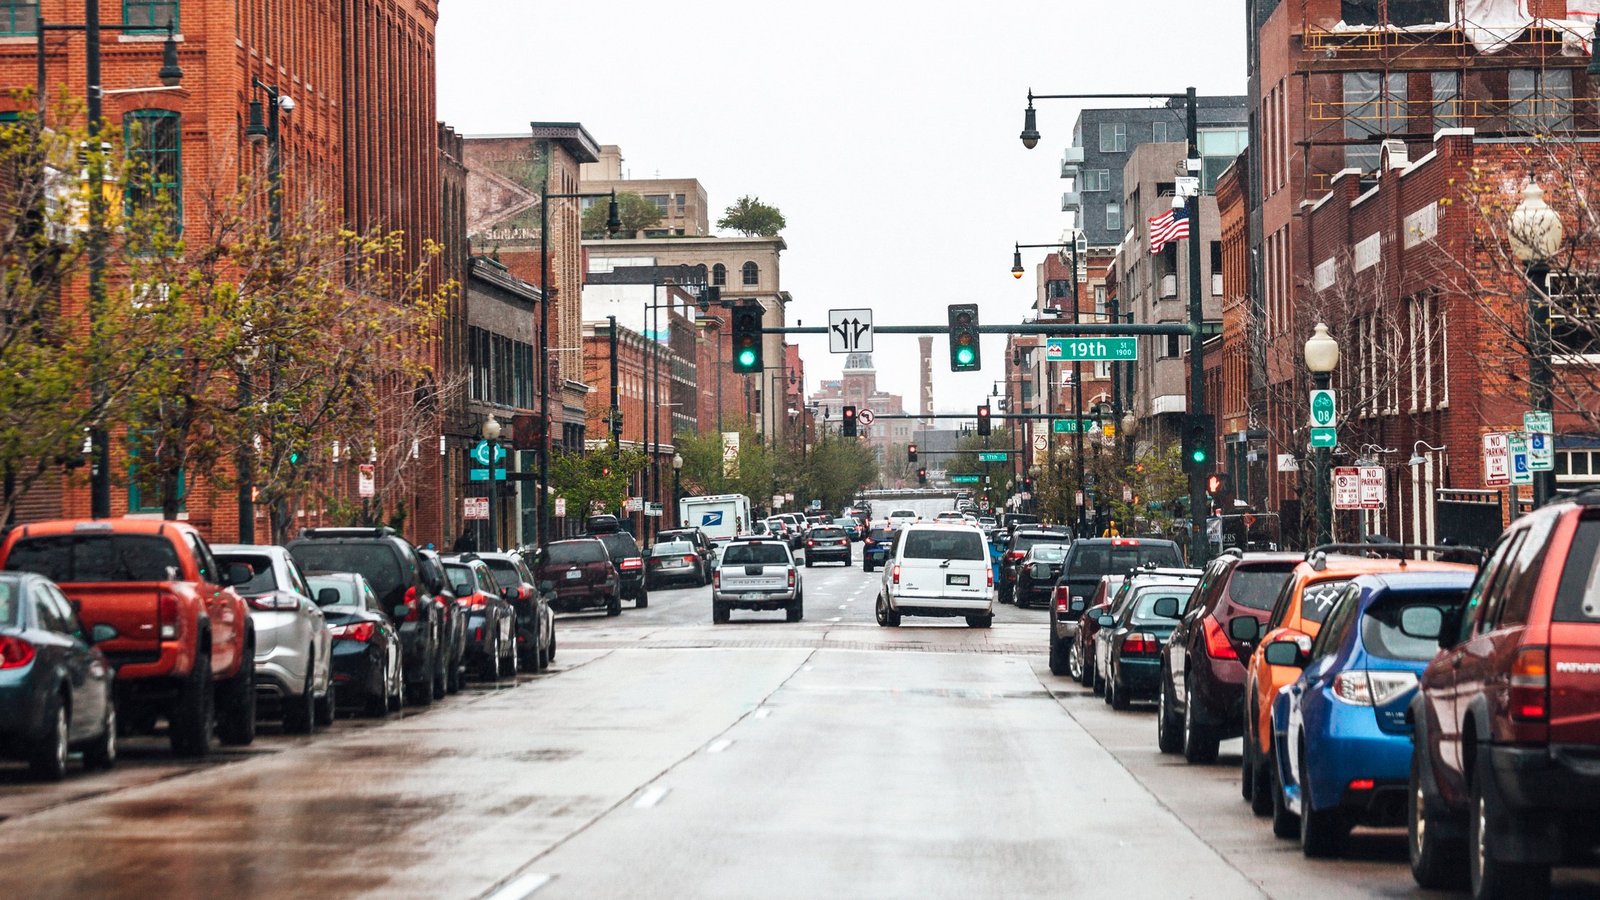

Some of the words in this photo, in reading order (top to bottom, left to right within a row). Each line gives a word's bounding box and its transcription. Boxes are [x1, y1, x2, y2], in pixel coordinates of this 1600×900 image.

[1069, 342, 1106, 357] 19th
[1317, 410, 1330, 422] D8
[1034, 434, 1048, 450] 75
[1490, 436, 1500, 446] NO
[1485, 447, 1507, 456] PARKING
[1366, 469, 1376, 477] NO
[1361, 478, 1382, 486] PARKING
